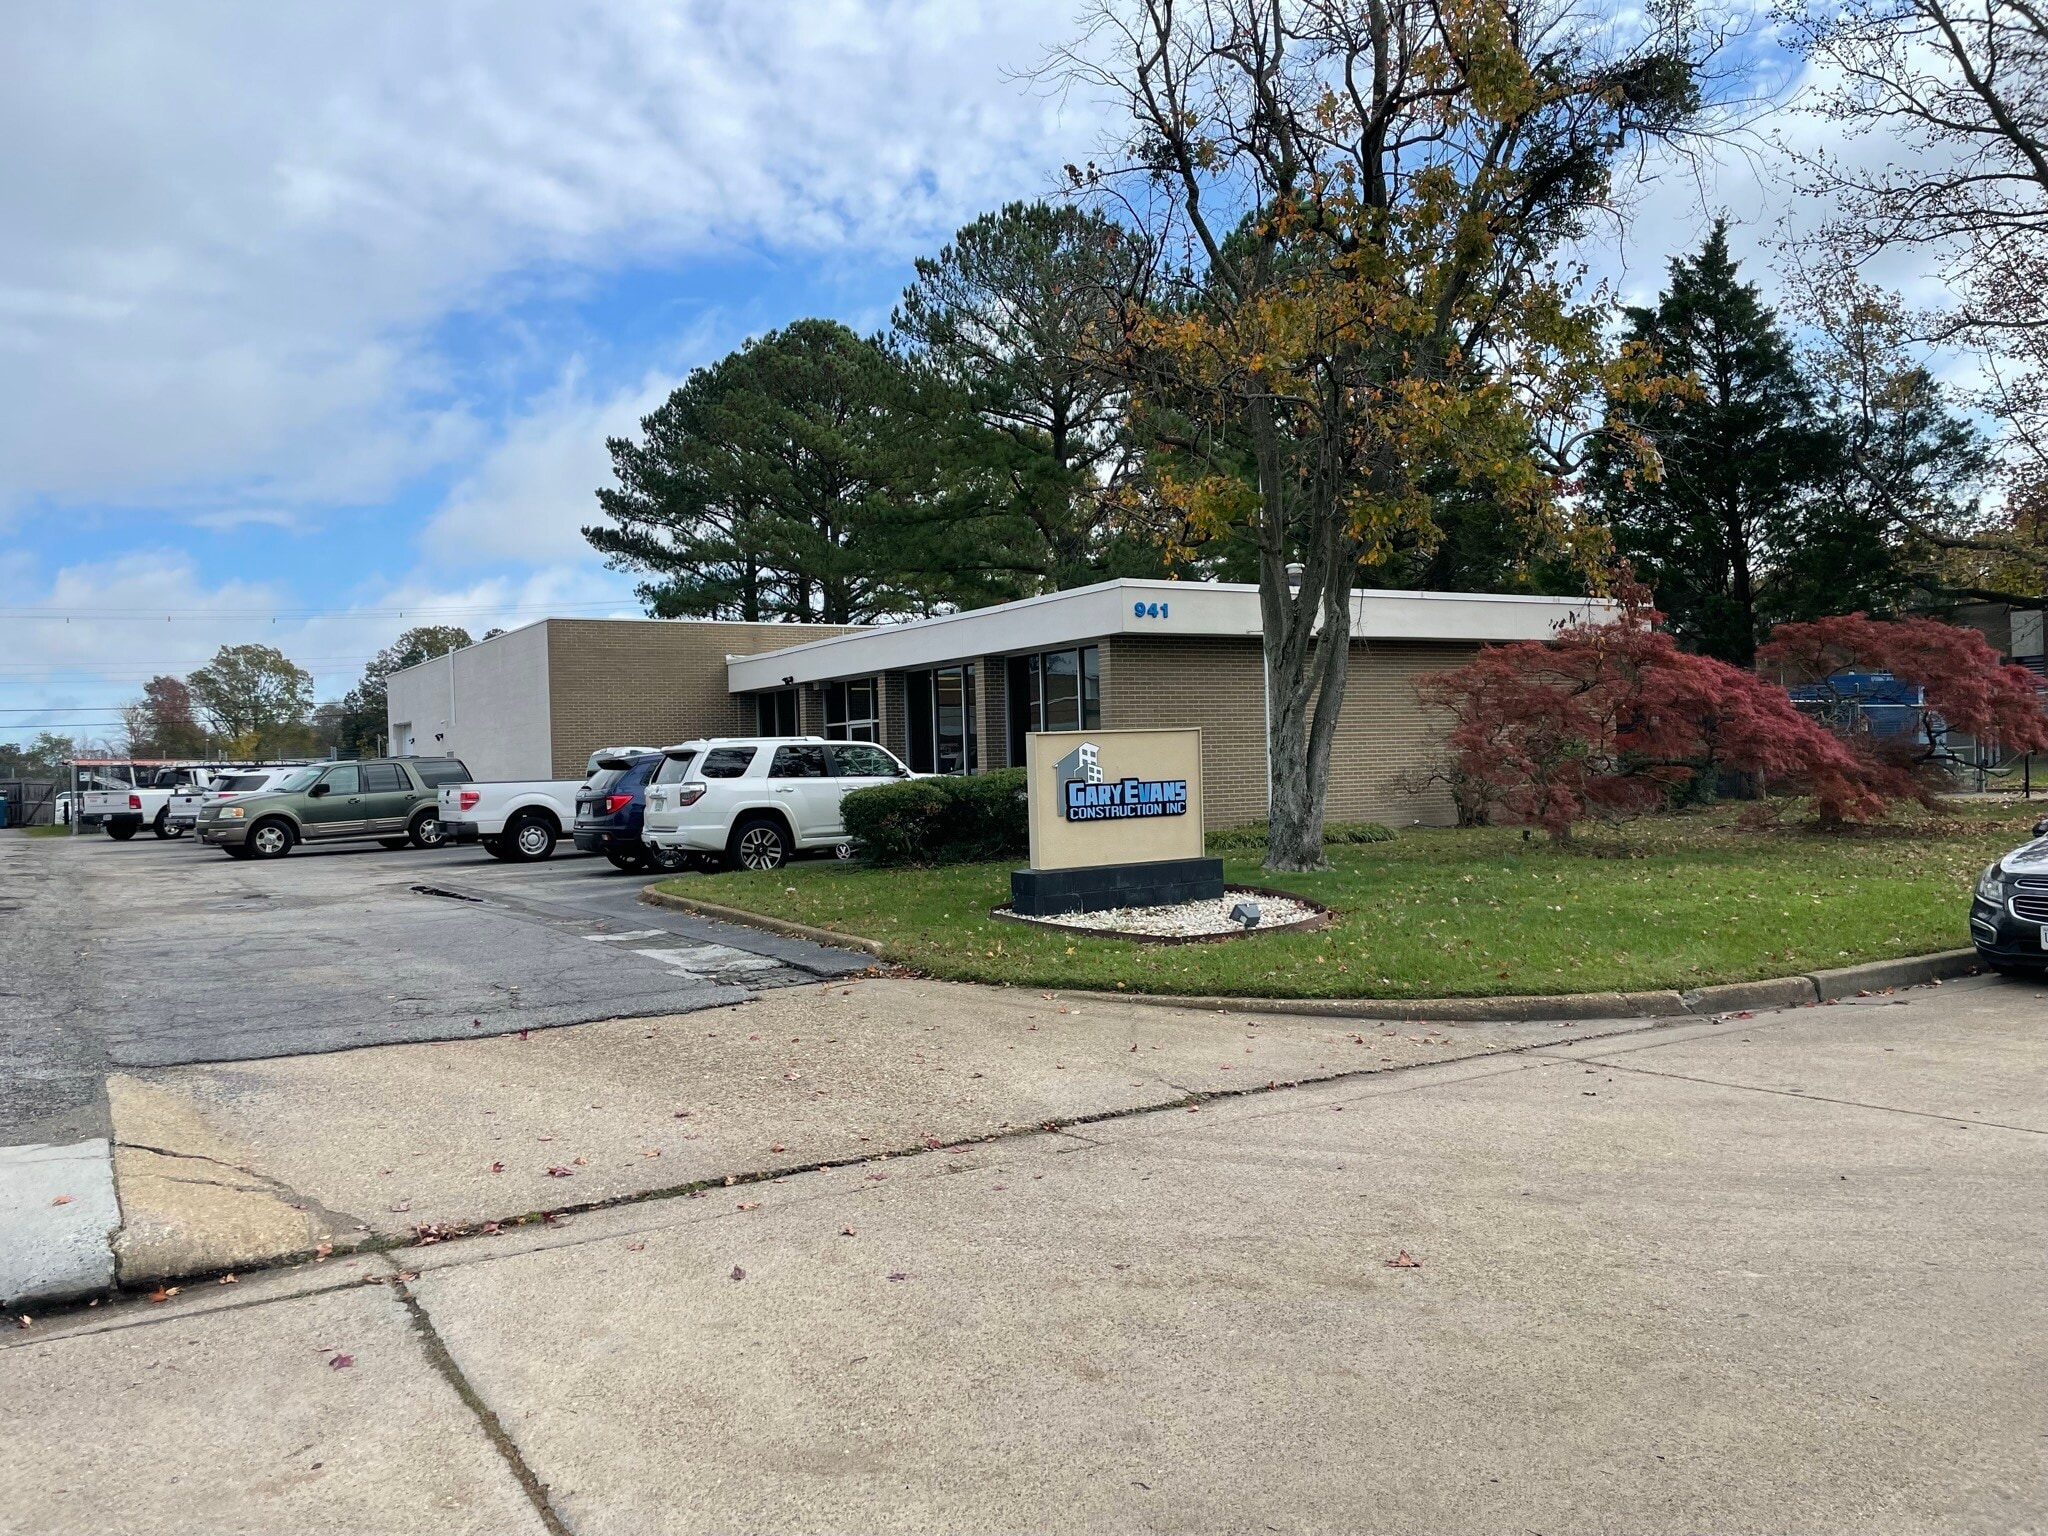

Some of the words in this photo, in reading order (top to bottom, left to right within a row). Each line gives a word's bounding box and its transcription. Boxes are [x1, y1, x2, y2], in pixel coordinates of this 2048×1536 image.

[1134, 602, 1169, 618] 941
[1068, 782, 1122, 806] GARY
[1124, 780, 1187, 803] EVANS
[1070, 803, 1162, 820] CONSTRUCTION
[1166, 801, 1186, 814] INC
